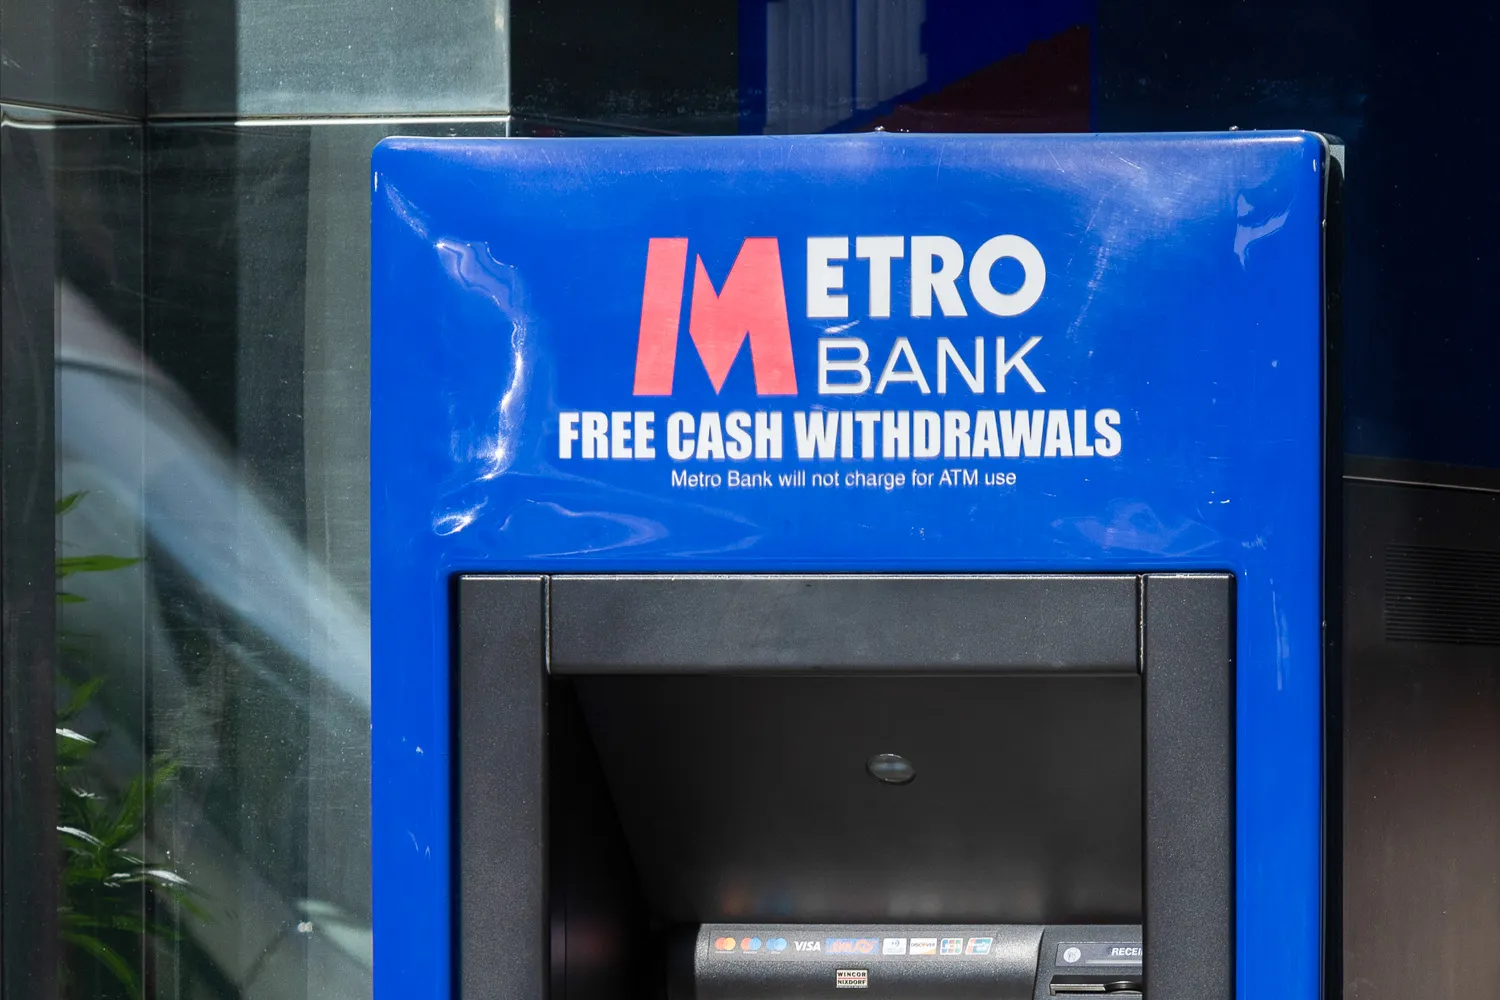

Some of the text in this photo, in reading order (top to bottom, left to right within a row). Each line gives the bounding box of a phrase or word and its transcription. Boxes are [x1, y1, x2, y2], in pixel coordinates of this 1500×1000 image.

[633, 234, 1046, 396] METRO
[817, 335, 1046, 395] BANK
[558, 407, 1122, 460] FREE CASH WITHDRAWALS
[671, 469, 1016, 491] Metro Bank will not charge for ATM use
[794, 941, 822, 951] VISA
